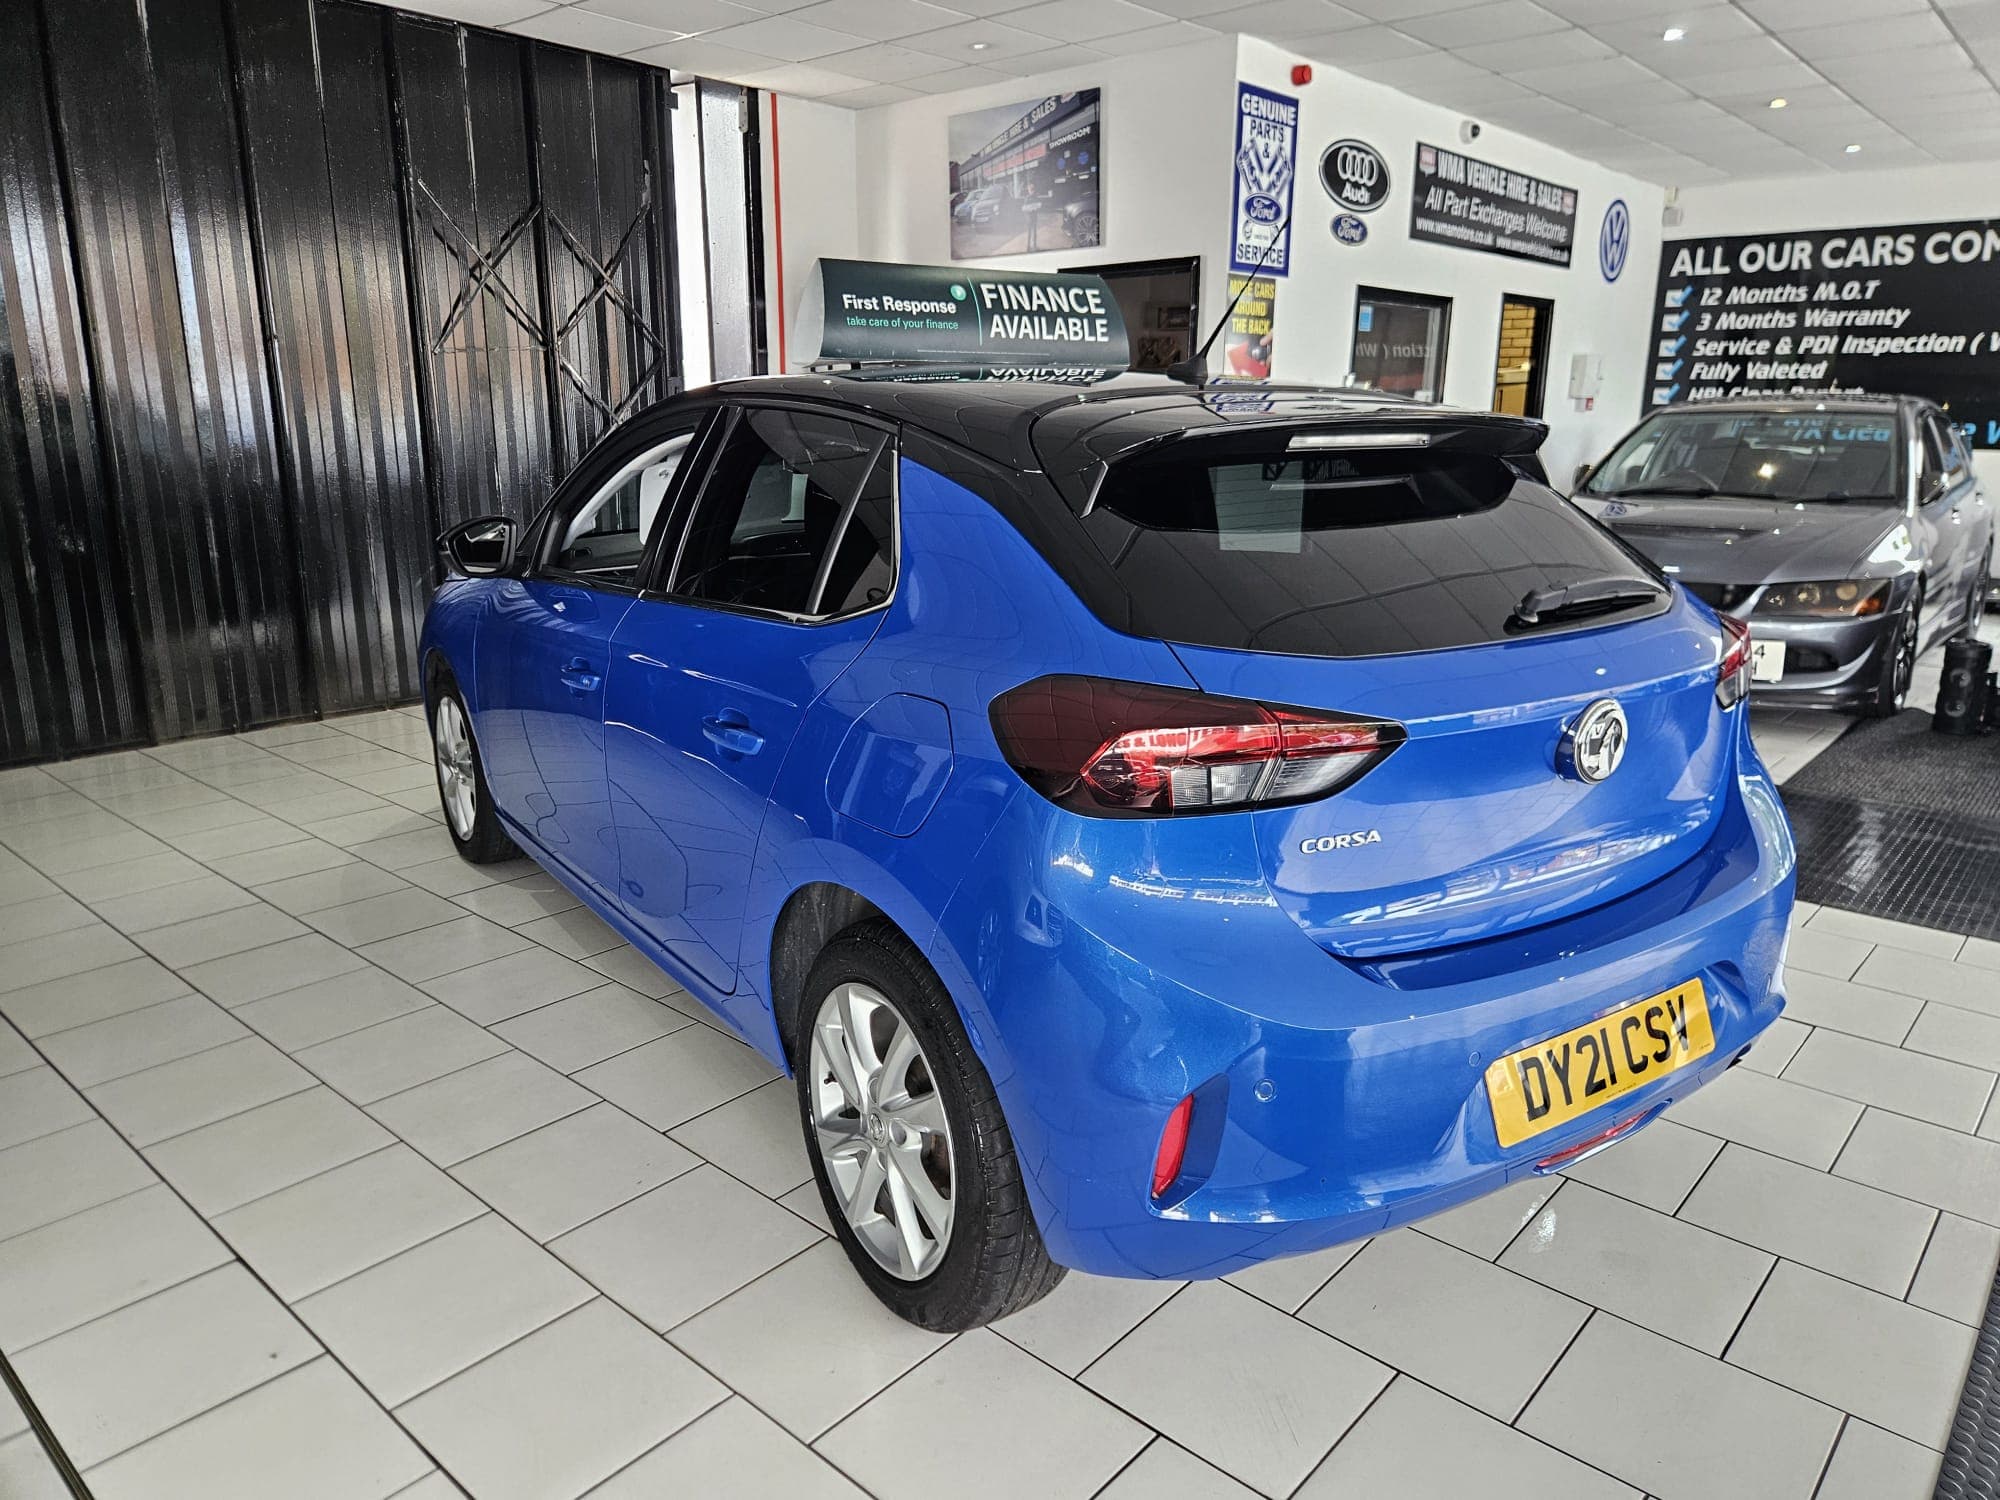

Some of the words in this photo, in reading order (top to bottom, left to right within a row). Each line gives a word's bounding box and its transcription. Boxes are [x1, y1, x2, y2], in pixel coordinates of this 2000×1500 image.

[1031, 96, 1057, 124] SALES
[1241, 93, 1297, 126] GENUINE
[1250, 119, 1284, 143] PARTS
[1262, 142, 1270, 159] &
[1341, 181, 1371, 204] Audi
[1437, 149, 1466, 185] WMA
[1466, 159, 1507, 197] VEHICLE
[1506, 172, 1529, 203] HIRE
[1528, 179, 1538, 206] &
[1537, 182, 1562, 213] SALES
[1250, 197, 1278, 221] Ford
[1424, 185, 1445, 212] All
[1443, 188, 1471, 219] Part
[1469, 195, 1526, 235] Exchanges
[1526, 211, 1568, 243] Welcome
[1337, 217, 1364, 241] Ford
[1237, 243, 1284, 265] SERVICE
[1669, 245, 1731, 278] ALL
[1738, 240, 1813, 274] OUR
[1821, 234, 1917, 269] CARS
[979, 283, 1106, 315] FINANCE
[1254, 282, 1275, 299] CARS
[1700, 287, 1723, 306] 12
[1725, 283, 1809, 305] Months
[1812, 280, 1882, 302] M.O.T
[842, 293, 879, 311] First
[882, 295, 957, 315] Response
[1234, 301, 1266, 317] AROUND
[846, 316, 867, 327] take
[868, 319, 889, 327] care
[891, 317, 901, 328] of
[903, 320, 924, 330] your
[926, 318, 959, 330] finance
[990, 314, 1110, 342] AVAILABLE
[1232, 318, 1247, 333] THE
[1248, 319, 1270, 335] BACK
[1695, 312, 1713, 331] 3
[1714, 309, 1797, 331] Months
[1804, 307, 1911, 329] Warranty
[1692, 337, 1771, 357] Service
[1774, 336, 1793, 355] &
[1797, 334, 1839, 355] PDI
[1841, 333, 1967, 357] Inspection
[1689, 361, 1741, 383] Fully
[1746, 360, 1828, 380] Valeted
[1300, 829, 1382, 854] CORSA
[1517, 1028, 1617, 1122] DY21
[1620, 994, 1689, 1075] CSV
